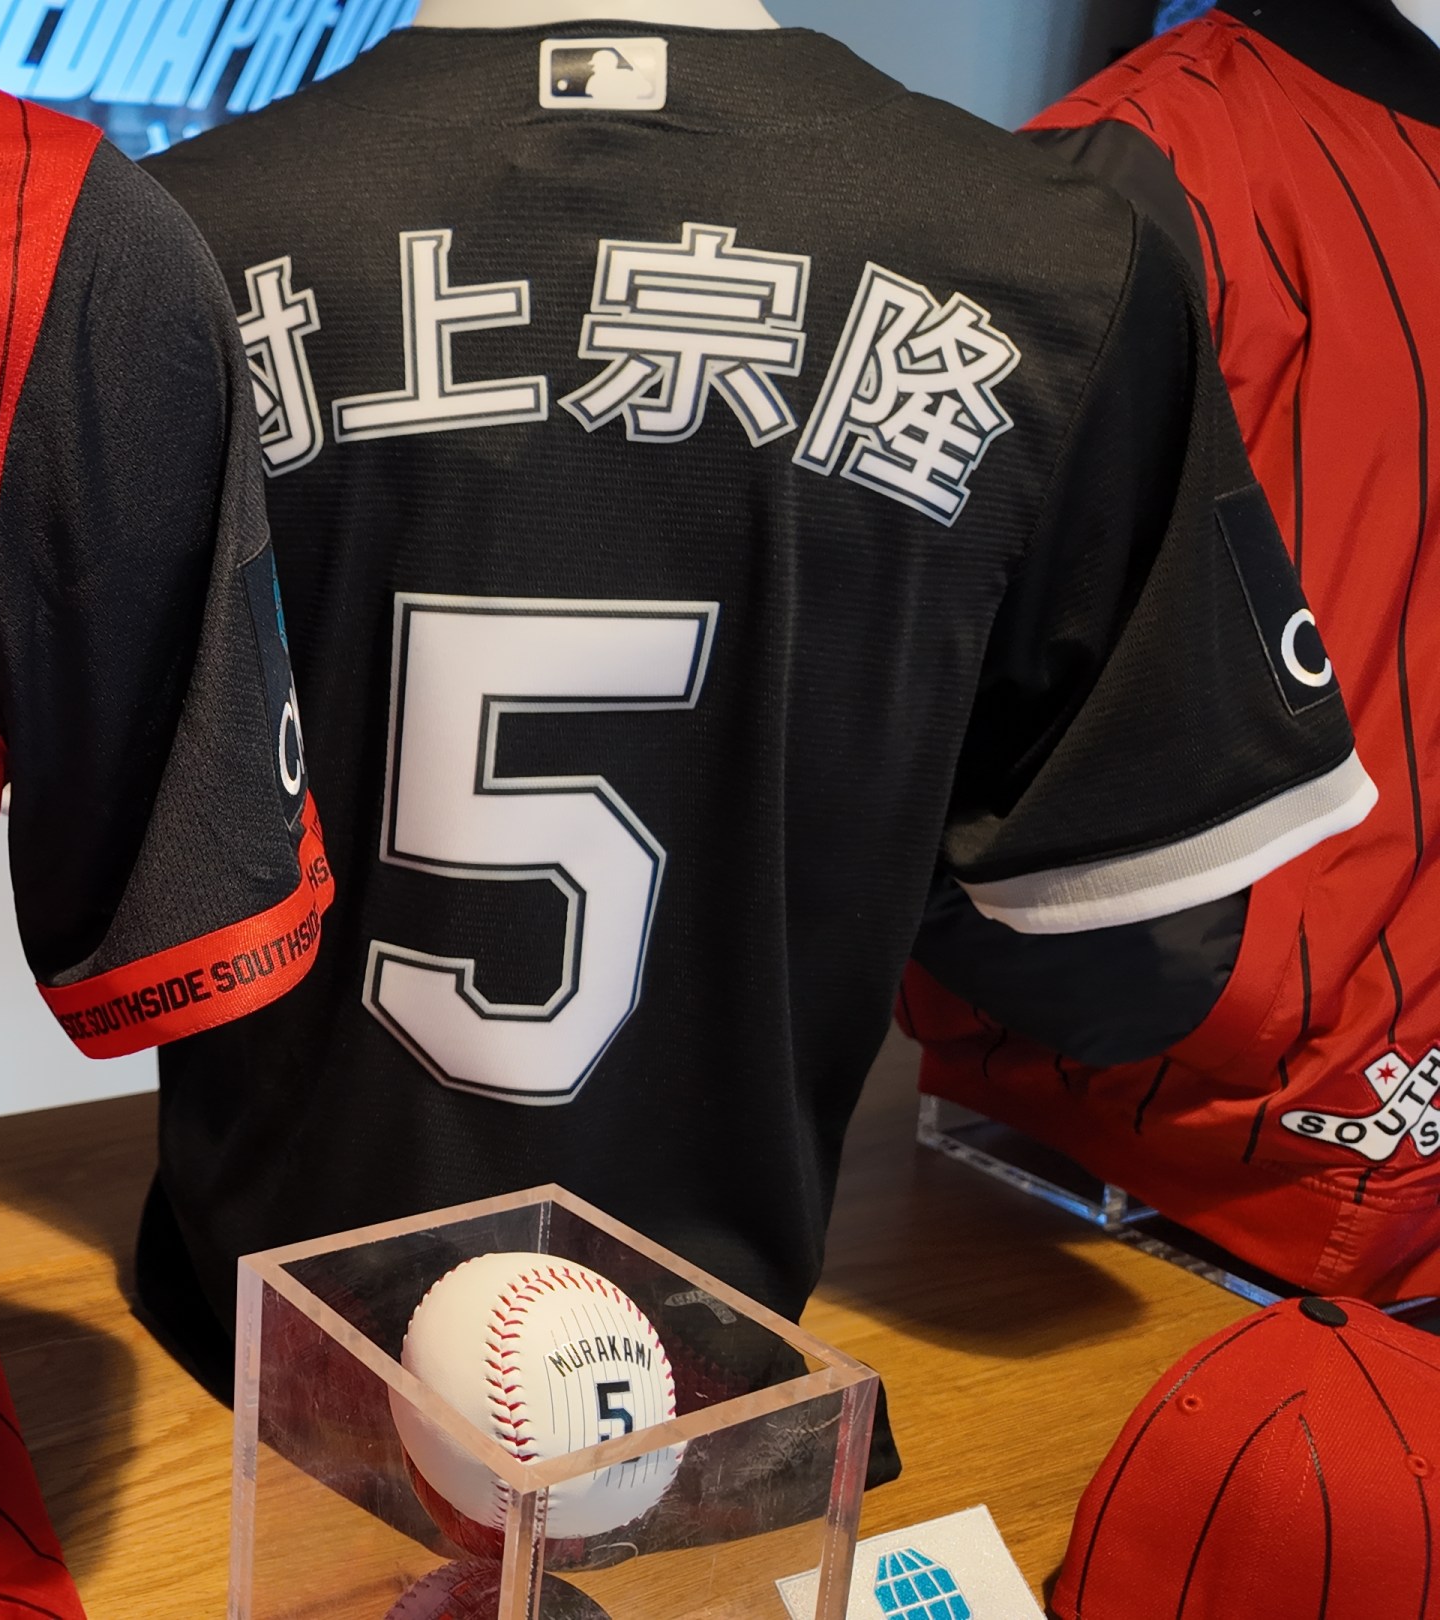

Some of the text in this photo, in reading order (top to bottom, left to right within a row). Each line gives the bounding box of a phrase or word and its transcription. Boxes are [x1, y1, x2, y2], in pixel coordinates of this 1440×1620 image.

[361, 591, 721, 1107] 5
[85, 968, 212, 1036] SOUTHSIDE
[1297, 1054, 1440, 1144] SOUTH
[548, 1335, 652, 1377] MURAKAMI
[595, 1379, 642, 1464] 5
